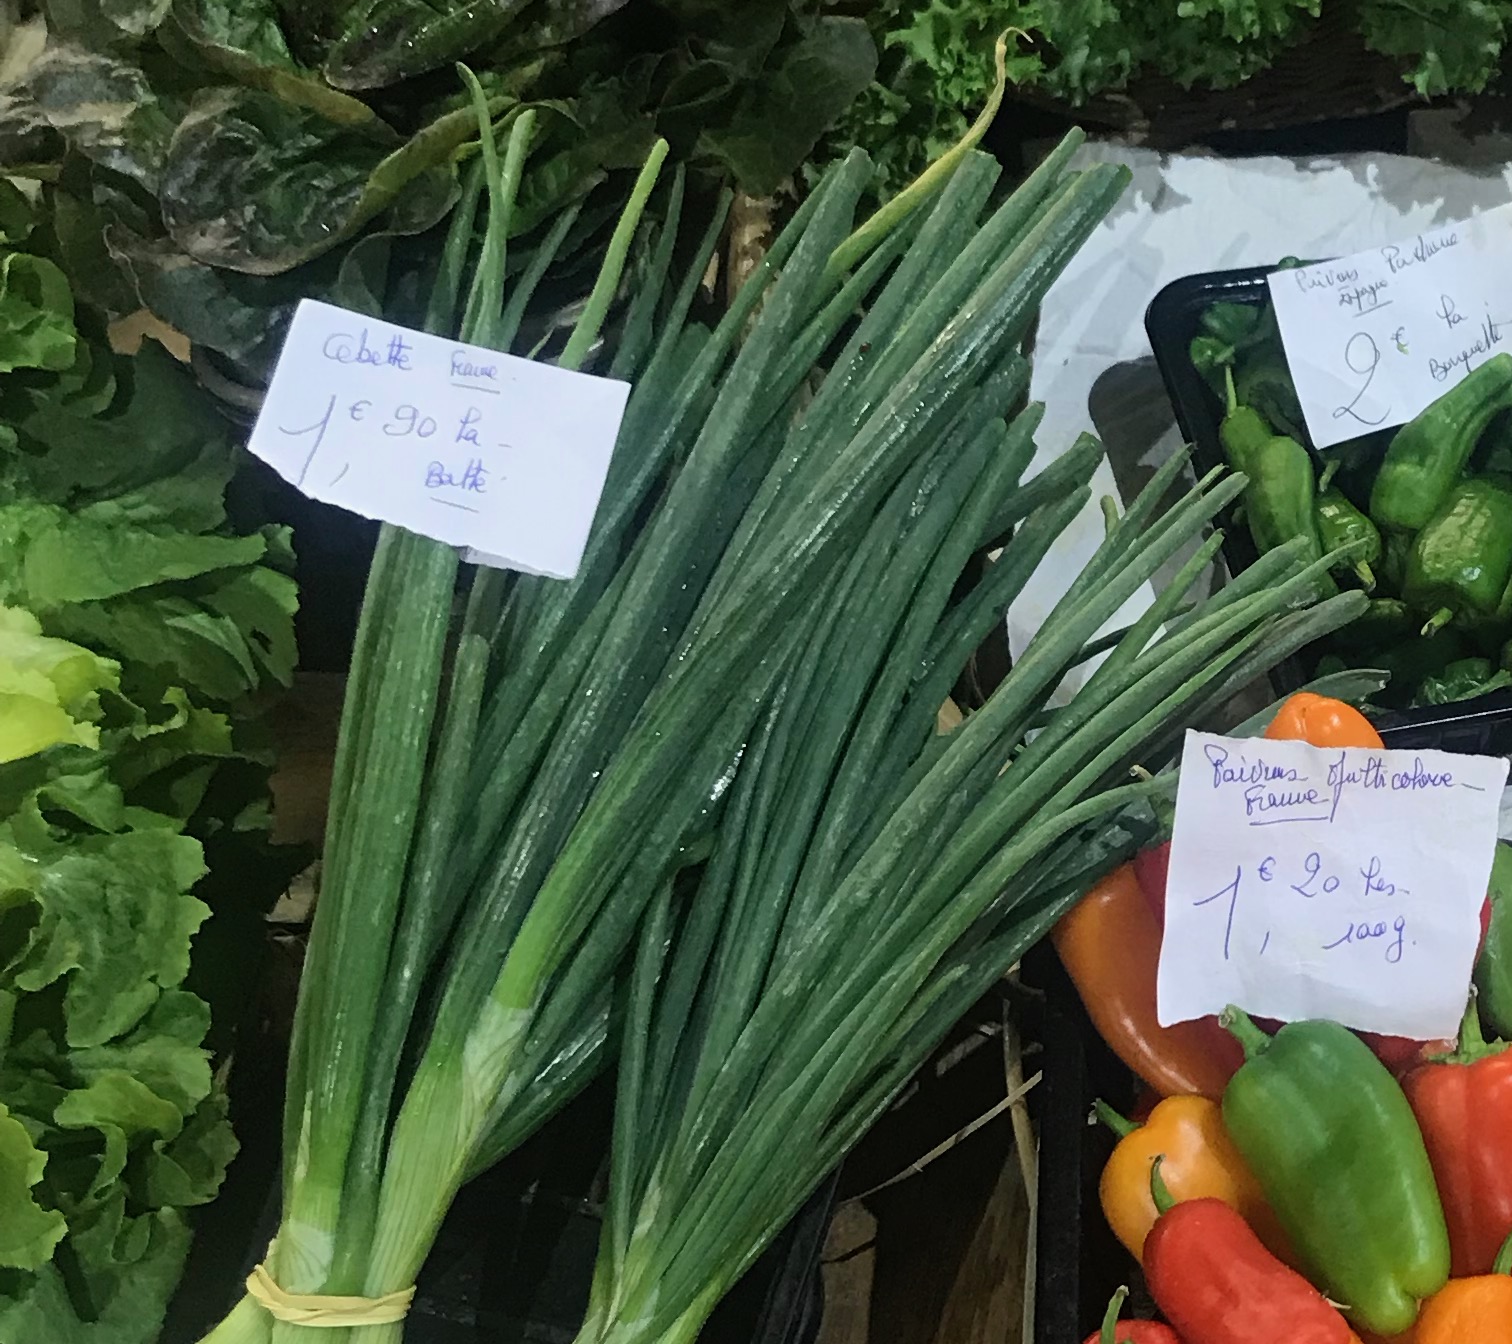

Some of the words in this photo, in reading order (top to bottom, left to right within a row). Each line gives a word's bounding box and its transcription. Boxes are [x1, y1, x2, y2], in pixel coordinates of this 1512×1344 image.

[1332, 331, 1393, 426] 2
[382, 404, 437, 439] 90
[1290, 852, 1341, 898] 20
